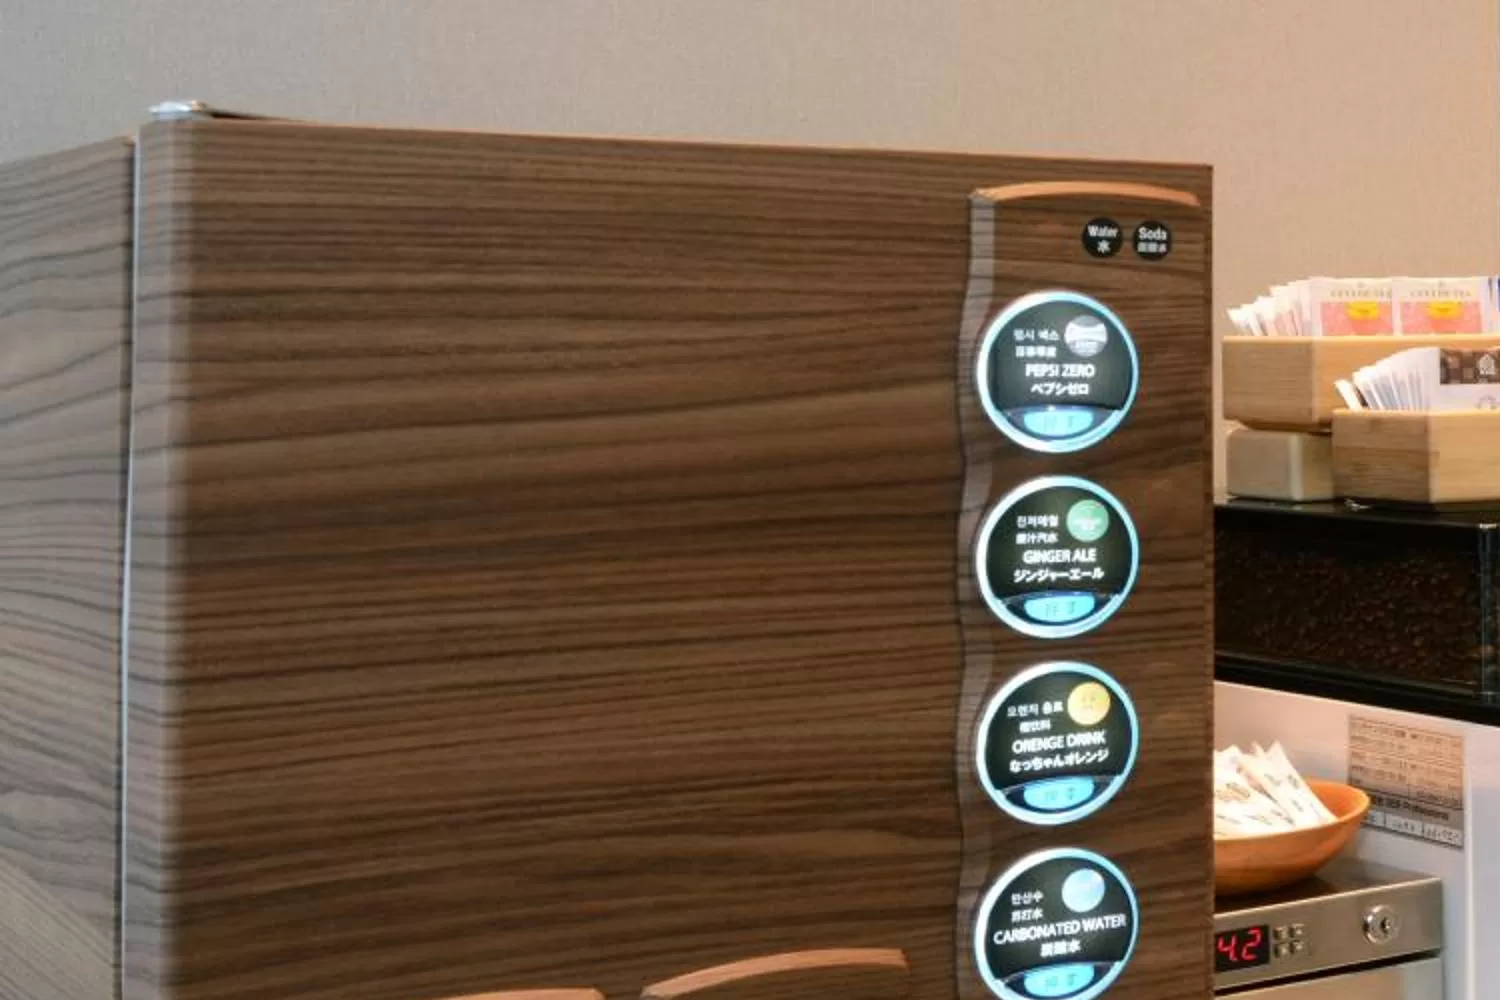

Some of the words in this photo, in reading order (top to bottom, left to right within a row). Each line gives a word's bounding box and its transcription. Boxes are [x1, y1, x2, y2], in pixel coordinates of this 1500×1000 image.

[1087, 225, 1118, 238] Water
[1138, 226, 1167, 240] Soda
[1025, 363, 1060, 378] PEPSI
[1061, 363, 1095, 379] ZERO
[1023, 549, 1070, 564] GINGER
[1072, 548, 1097, 562] ALE
[1013, 568, 1105, 583] ジンジャーエール
[1066, 730, 1107, 748] DRINK
[993, 920, 1081, 945] CARBONATED
[1082, 914, 1127, 932] WATER
